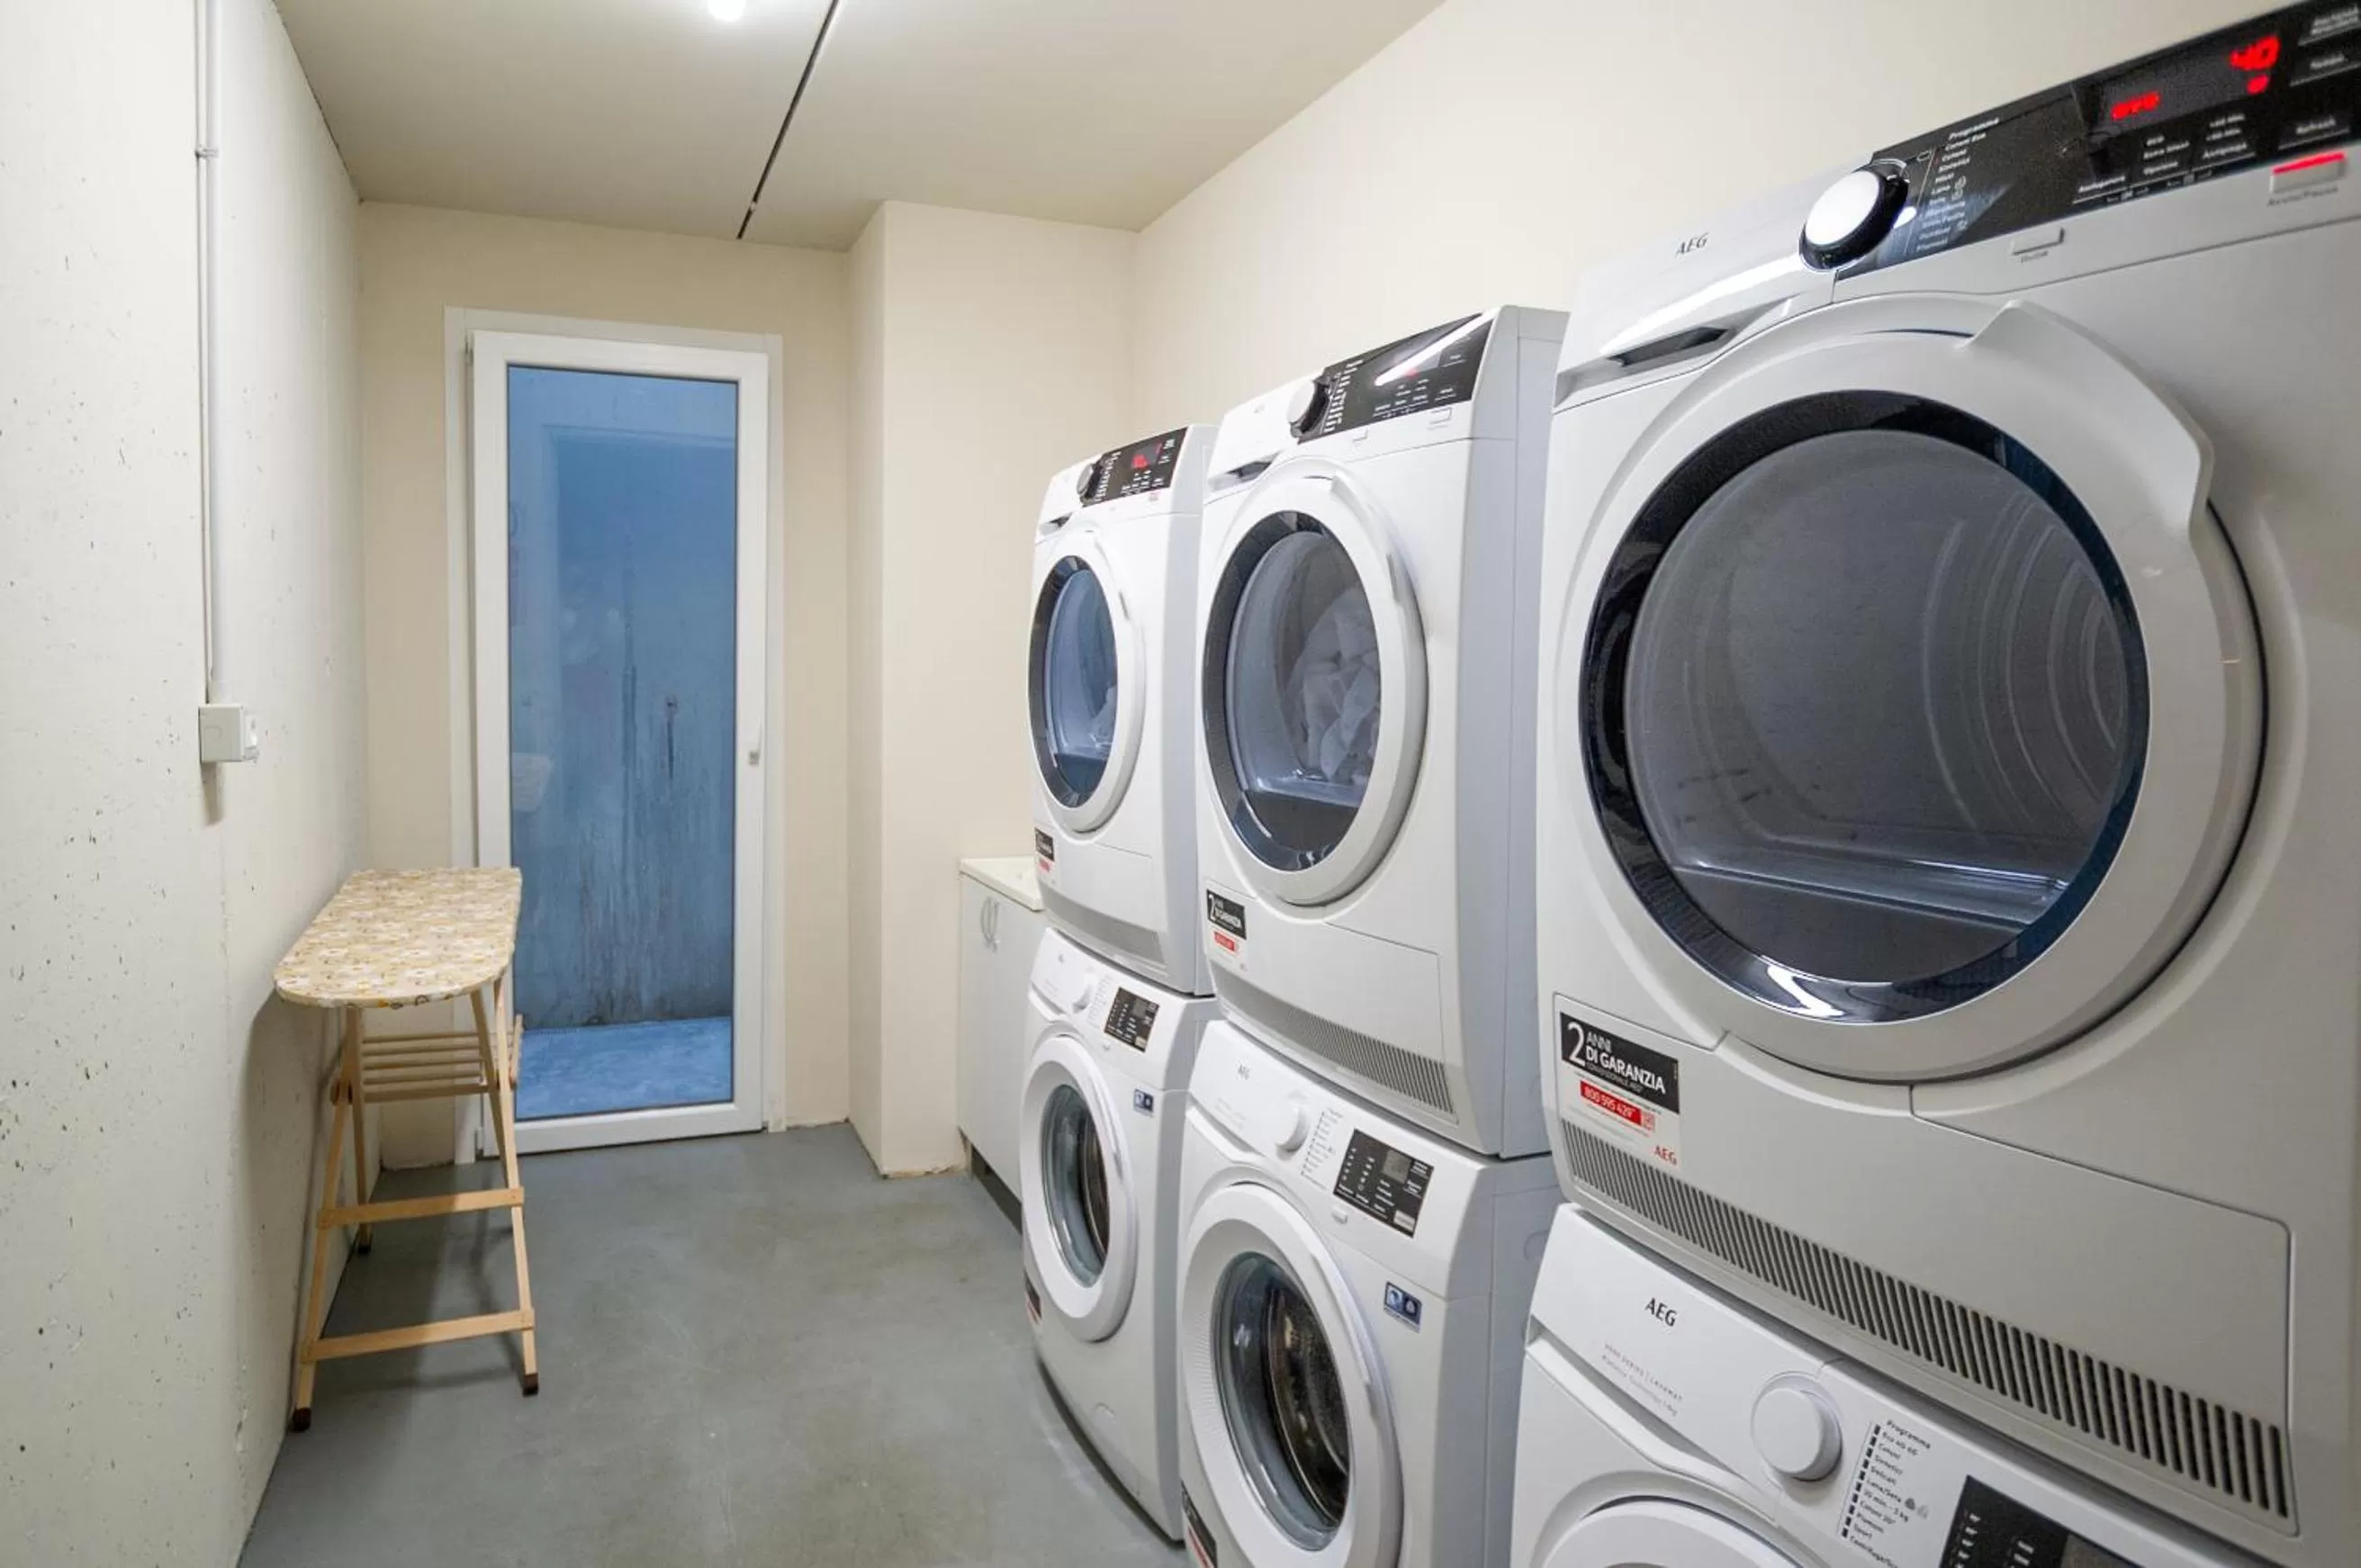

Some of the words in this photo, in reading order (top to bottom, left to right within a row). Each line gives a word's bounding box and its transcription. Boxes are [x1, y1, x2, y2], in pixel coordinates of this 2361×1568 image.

[1674, 230, 1710, 258] AEG
[1567, 1022, 1585, 1067] 2
[1586, 1031, 1612, 1053] ANNI
[1585, 1045, 1598, 1064] DI
[1600, 1051, 1666, 1095] GARANZIA
[1654, 1145, 1677, 1166] AEG
[1645, 1297, 1677, 1327] AEG
